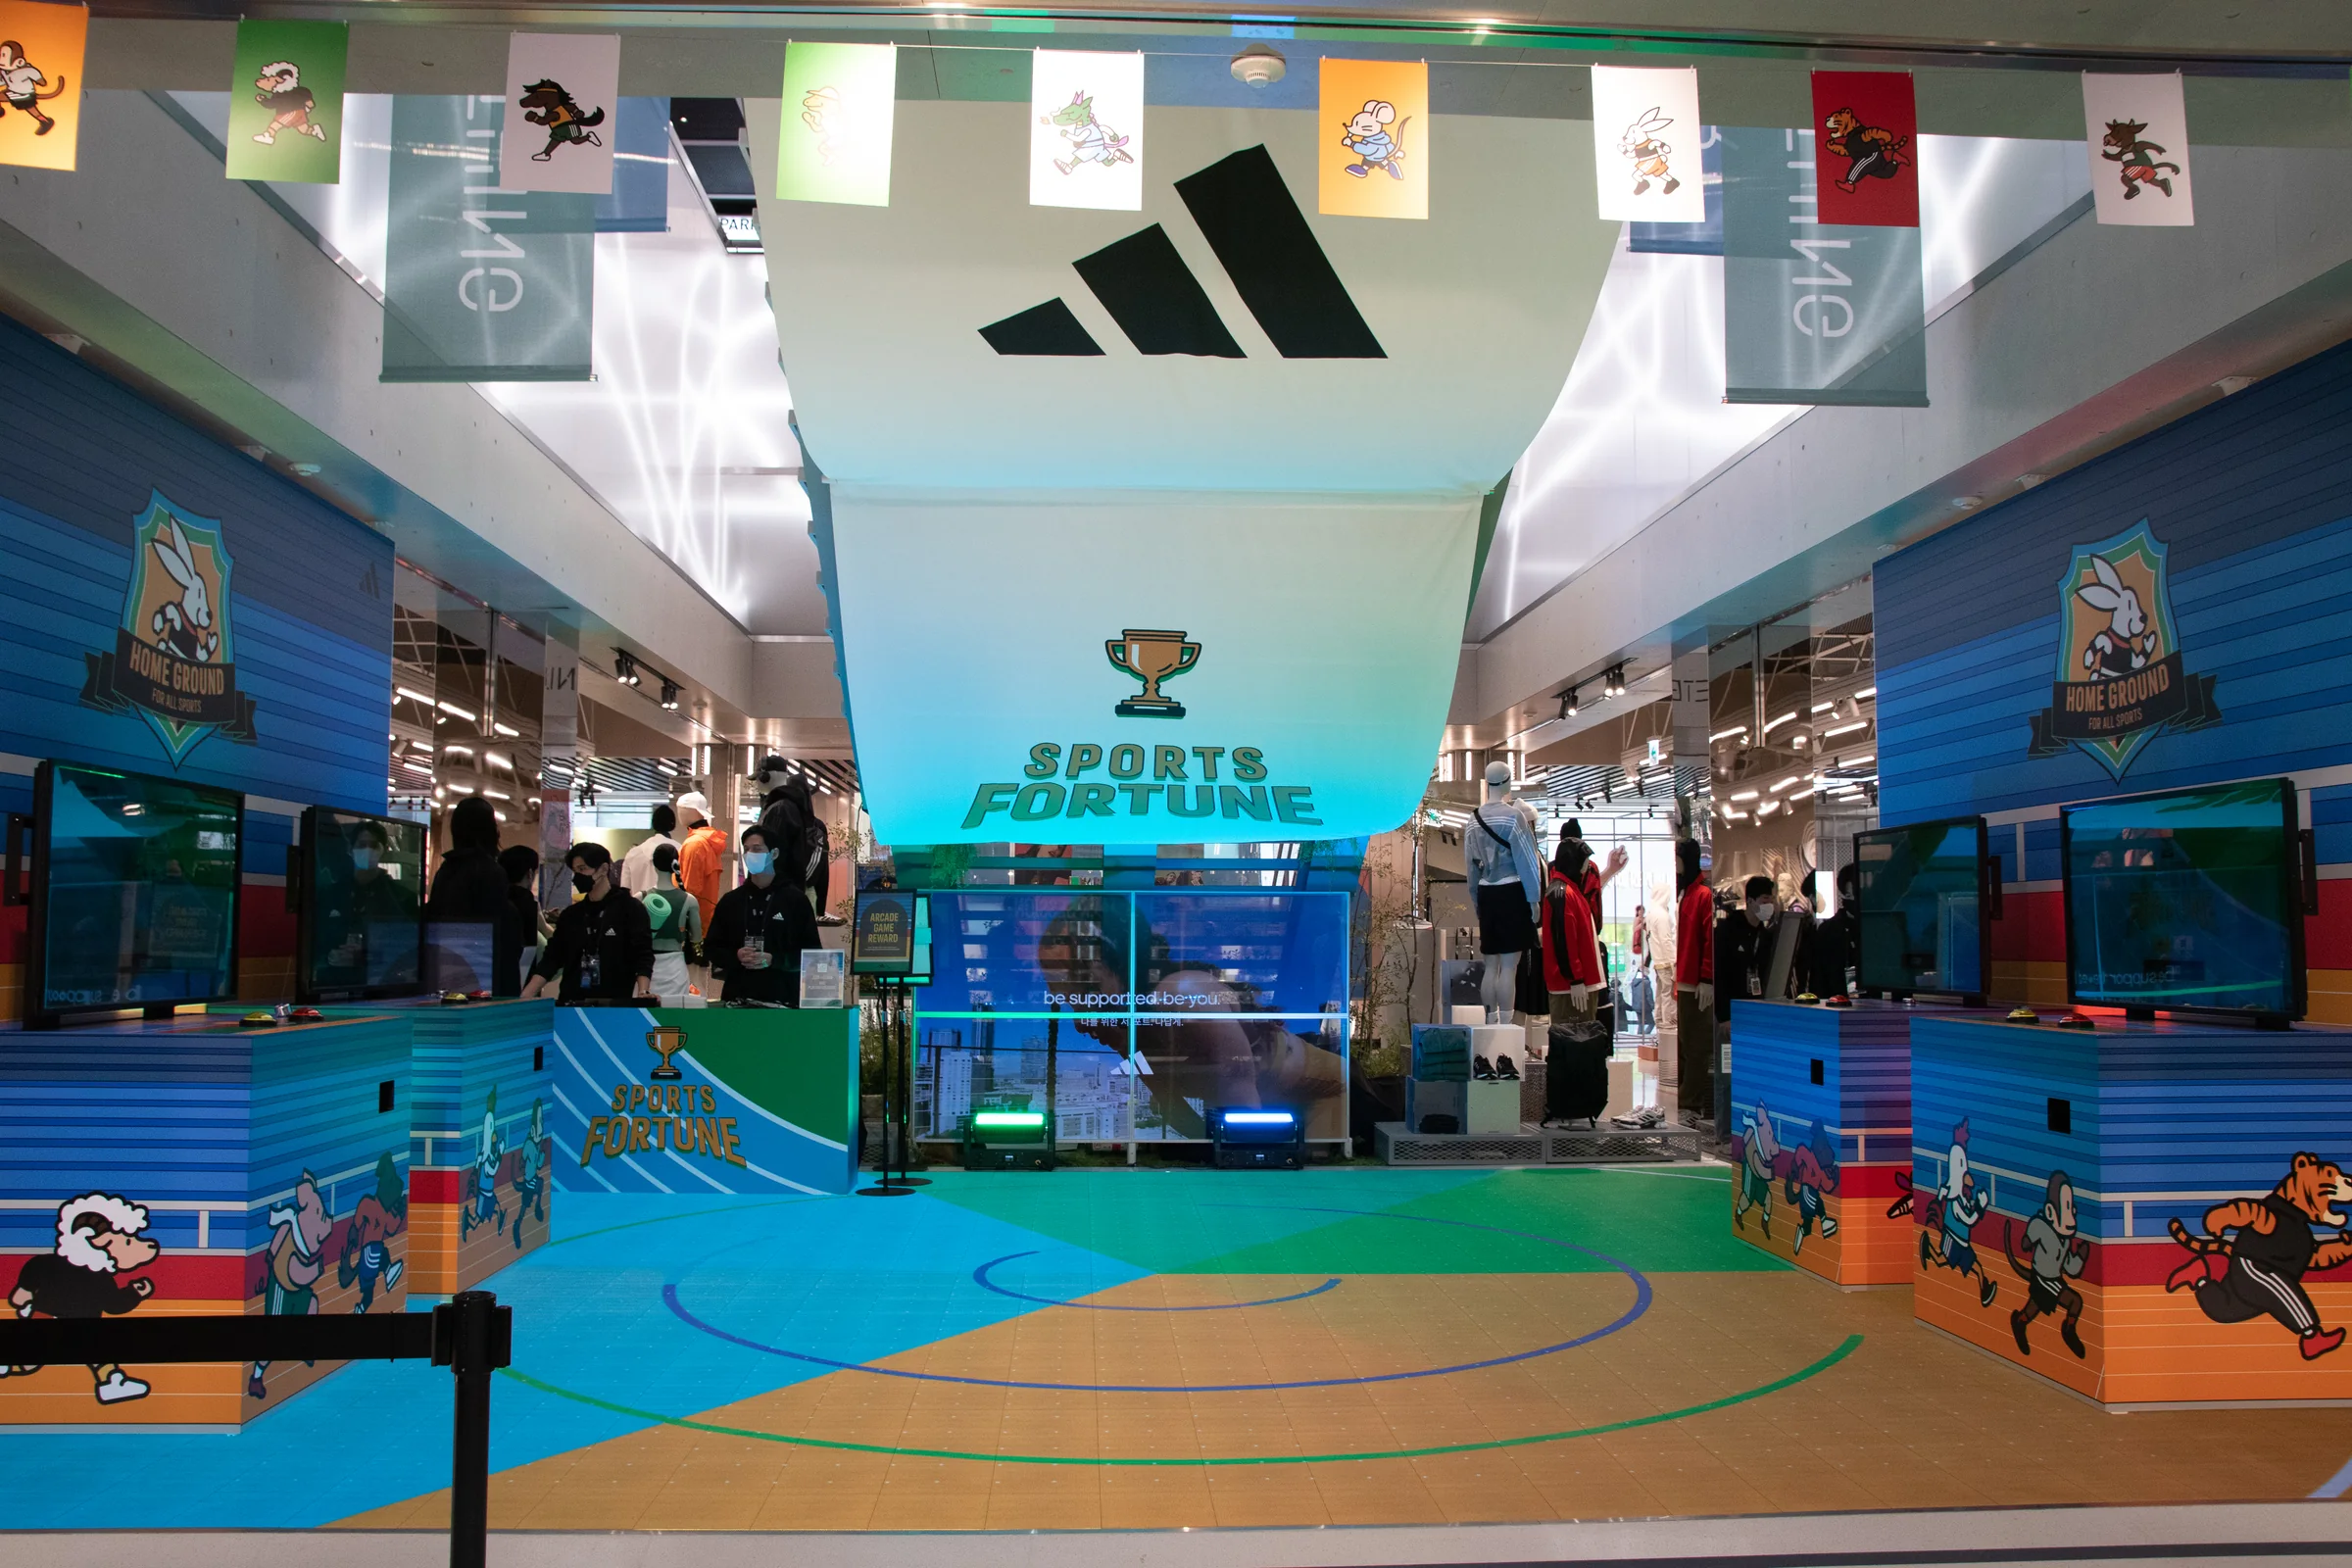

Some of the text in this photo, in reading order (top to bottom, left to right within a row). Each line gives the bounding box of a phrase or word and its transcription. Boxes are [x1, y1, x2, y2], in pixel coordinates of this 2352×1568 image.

[129, 641, 224, 695] HOME GROUND
[152, 688, 202, 713] FOR ALL SPORTS
[2065, 663, 2170, 711] HOME GROUND
[2088, 707, 2143, 729] FOR ALL SPORTS
[1024, 743, 1268, 781] SPORTS
[960, 782, 1324, 829] FORTUNE
[870, 912, 899, 922] ARCADE
[873, 923, 894, 932] GAME
[867, 934, 899, 943] REWARD
[1044, 991, 1065, 1005] be
[1163, 991, 1185, 1005] be
[1189, 994, 1221, 1008] you.
[612, 1084, 716, 1113] SPORTS
[580, 1116, 747, 1168] FORTUNE
